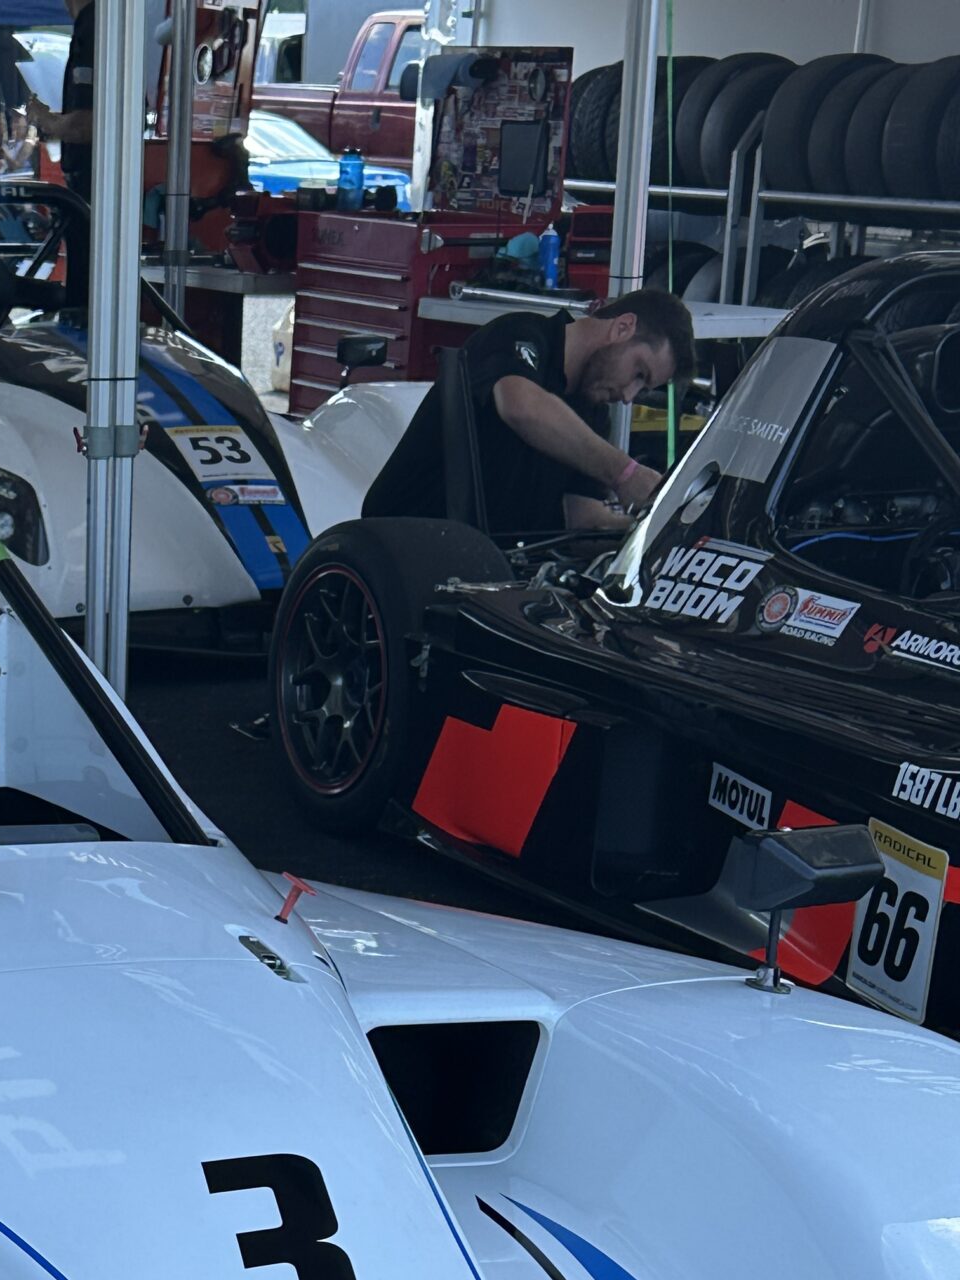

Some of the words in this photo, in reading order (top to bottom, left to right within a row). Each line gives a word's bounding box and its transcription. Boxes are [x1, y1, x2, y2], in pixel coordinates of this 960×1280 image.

[189, 436, 252, 465] 53
[660, 546, 766, 591] WACO
[644, 579, 744, 624] BOOM
[712, 771, 767, 827] MOTUL
[892, 761, 943, 809] 1587
[874, 829, 938, 870] RADICAL
[857, 877, 930, 983] 66
